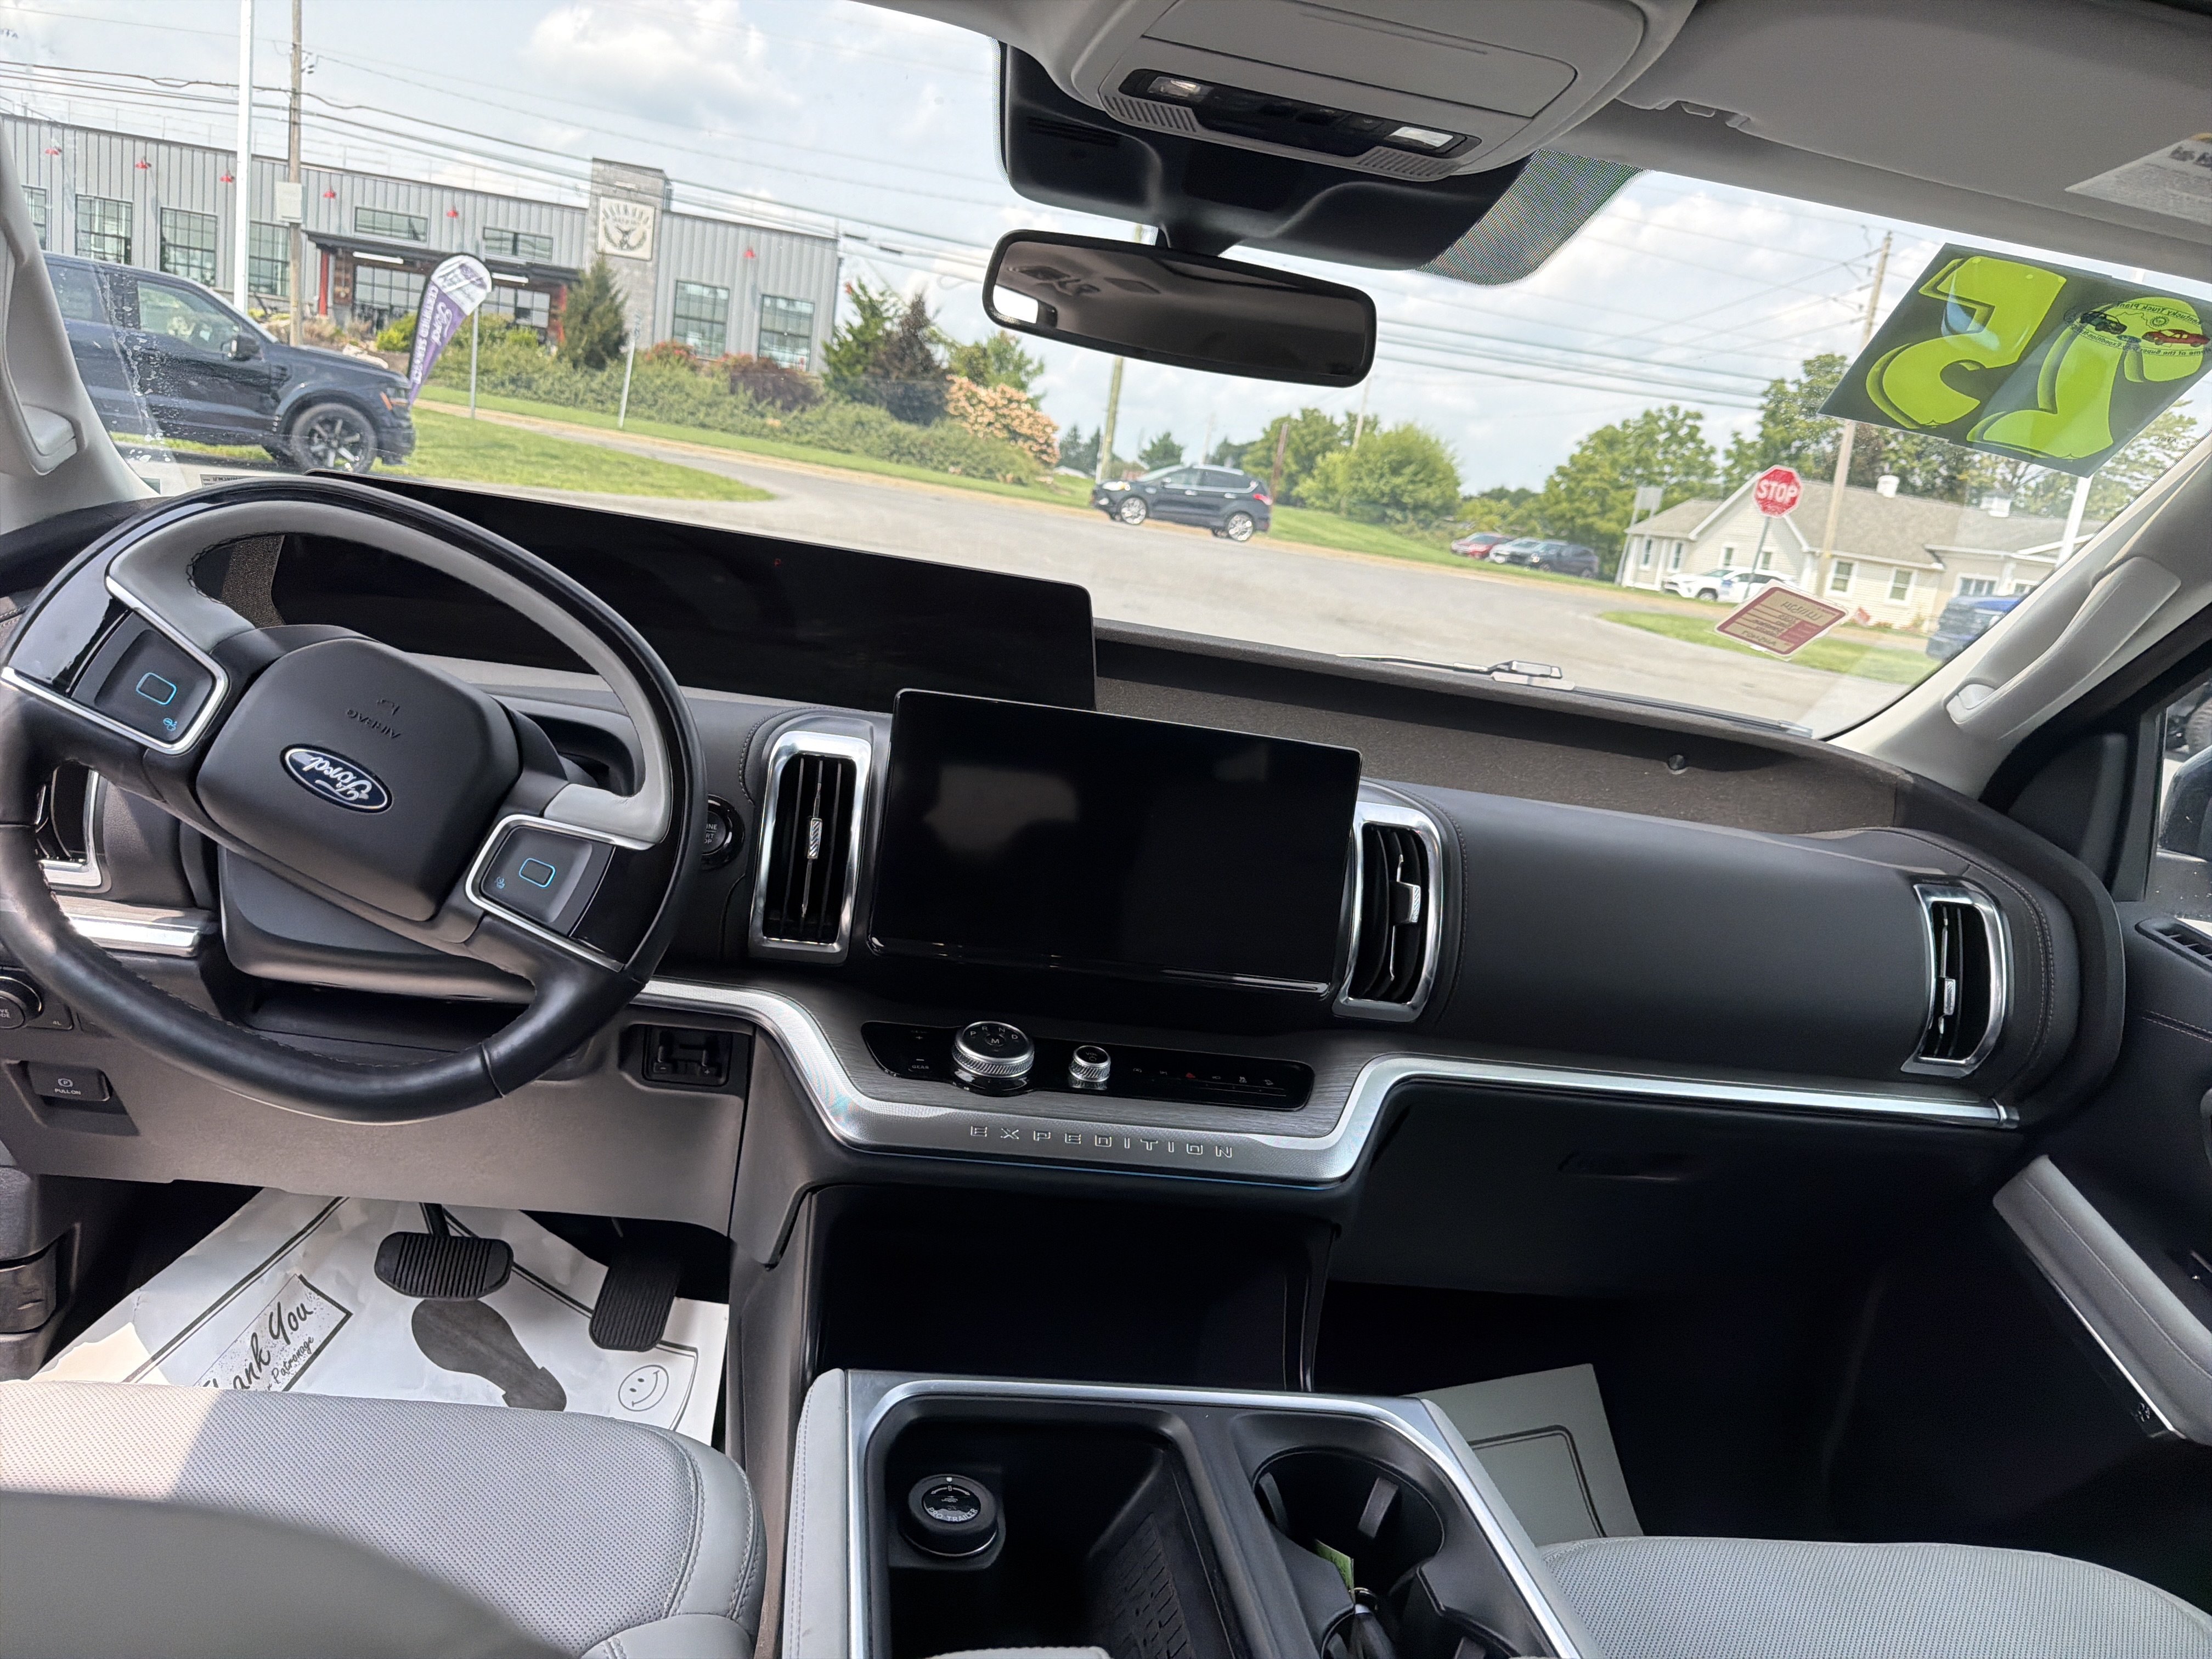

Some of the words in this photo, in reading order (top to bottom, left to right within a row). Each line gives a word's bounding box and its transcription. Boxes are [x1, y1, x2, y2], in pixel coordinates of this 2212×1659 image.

[1757, 479, 1798, 504] STOP
[302, 757, 372, 800] Ford
[970, 1125, 1232, 1158] EXPEDITION
[268, 1301, 314, 1345] You
[272, 1336, 314, 1384] Patronage
[927, 1507, 943, 1519] PRO
[946, 1508, 978, 1522] TRAILER
